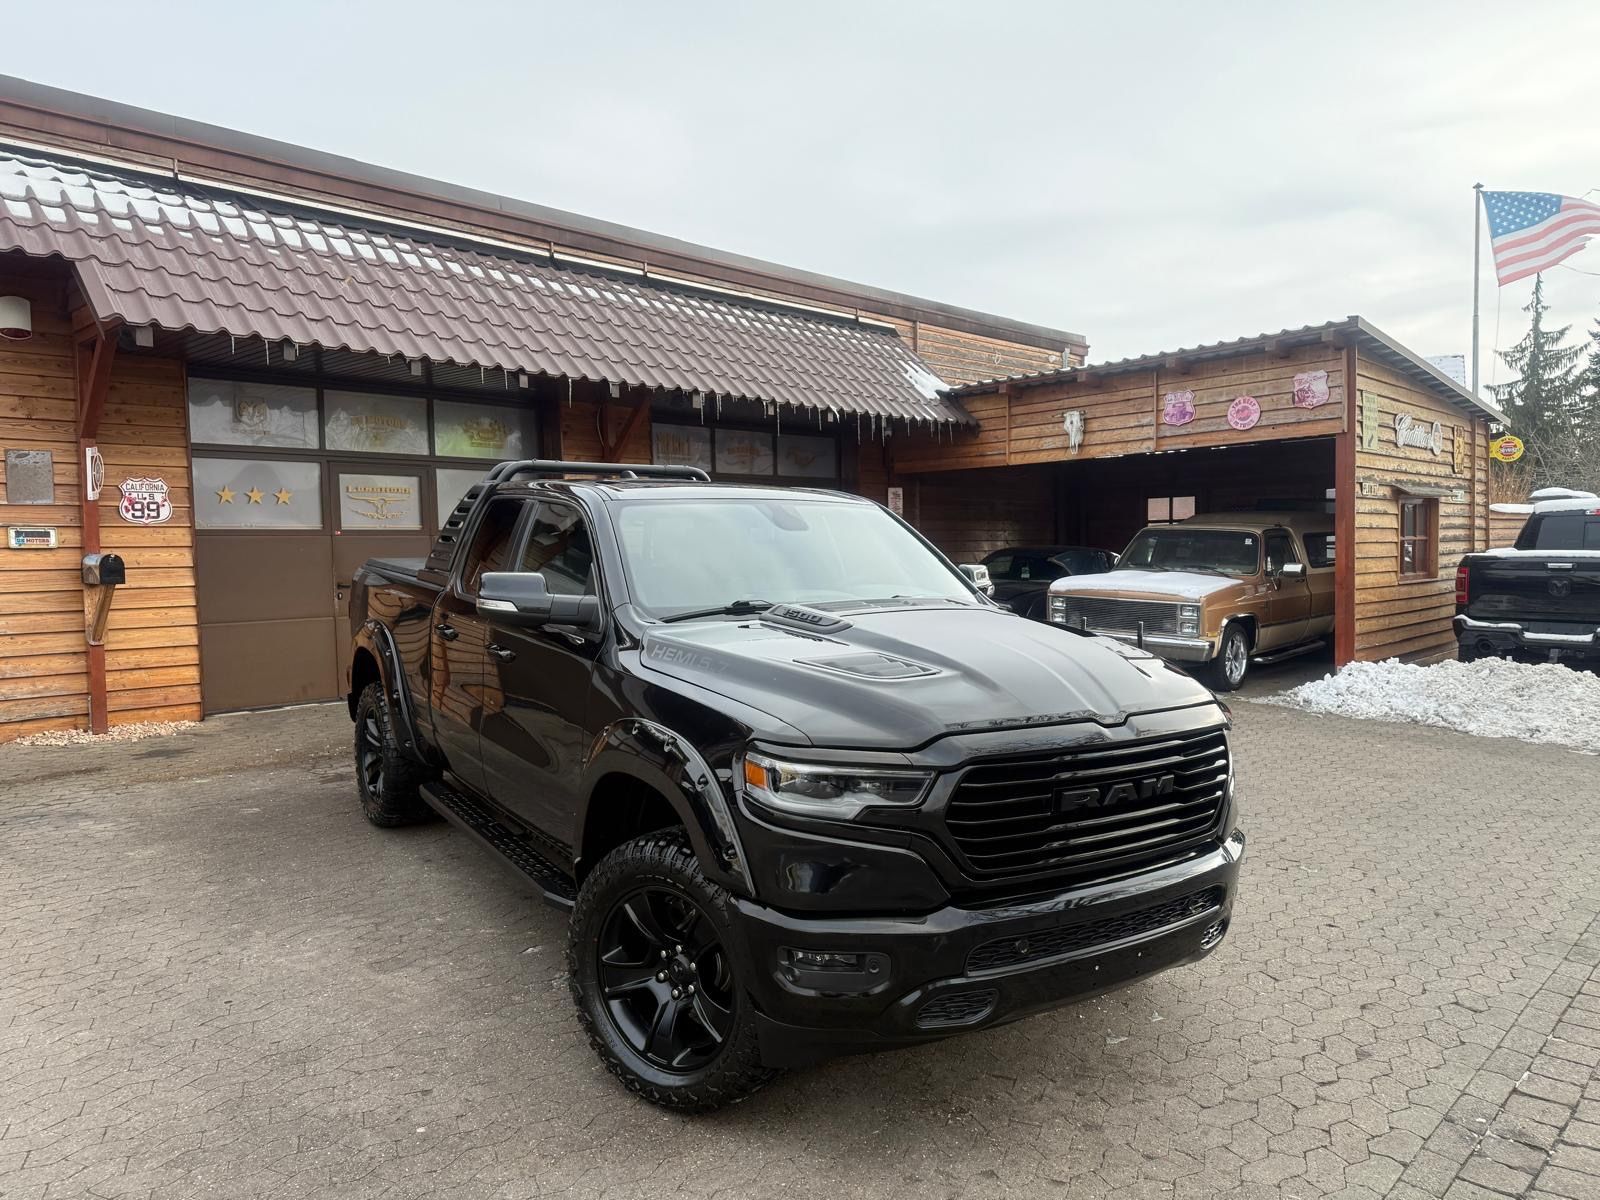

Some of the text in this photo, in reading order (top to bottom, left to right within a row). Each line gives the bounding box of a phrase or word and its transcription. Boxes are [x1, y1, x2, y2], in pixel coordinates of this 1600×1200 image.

[125, 482, 165, 491] CALIFORNIA
[131, 501, 161, 520] 99
[783, 608, 823, 624] 1500
[651, 644, 697, 666] HEMI
[1061, 774, 1175, 812] RAM
